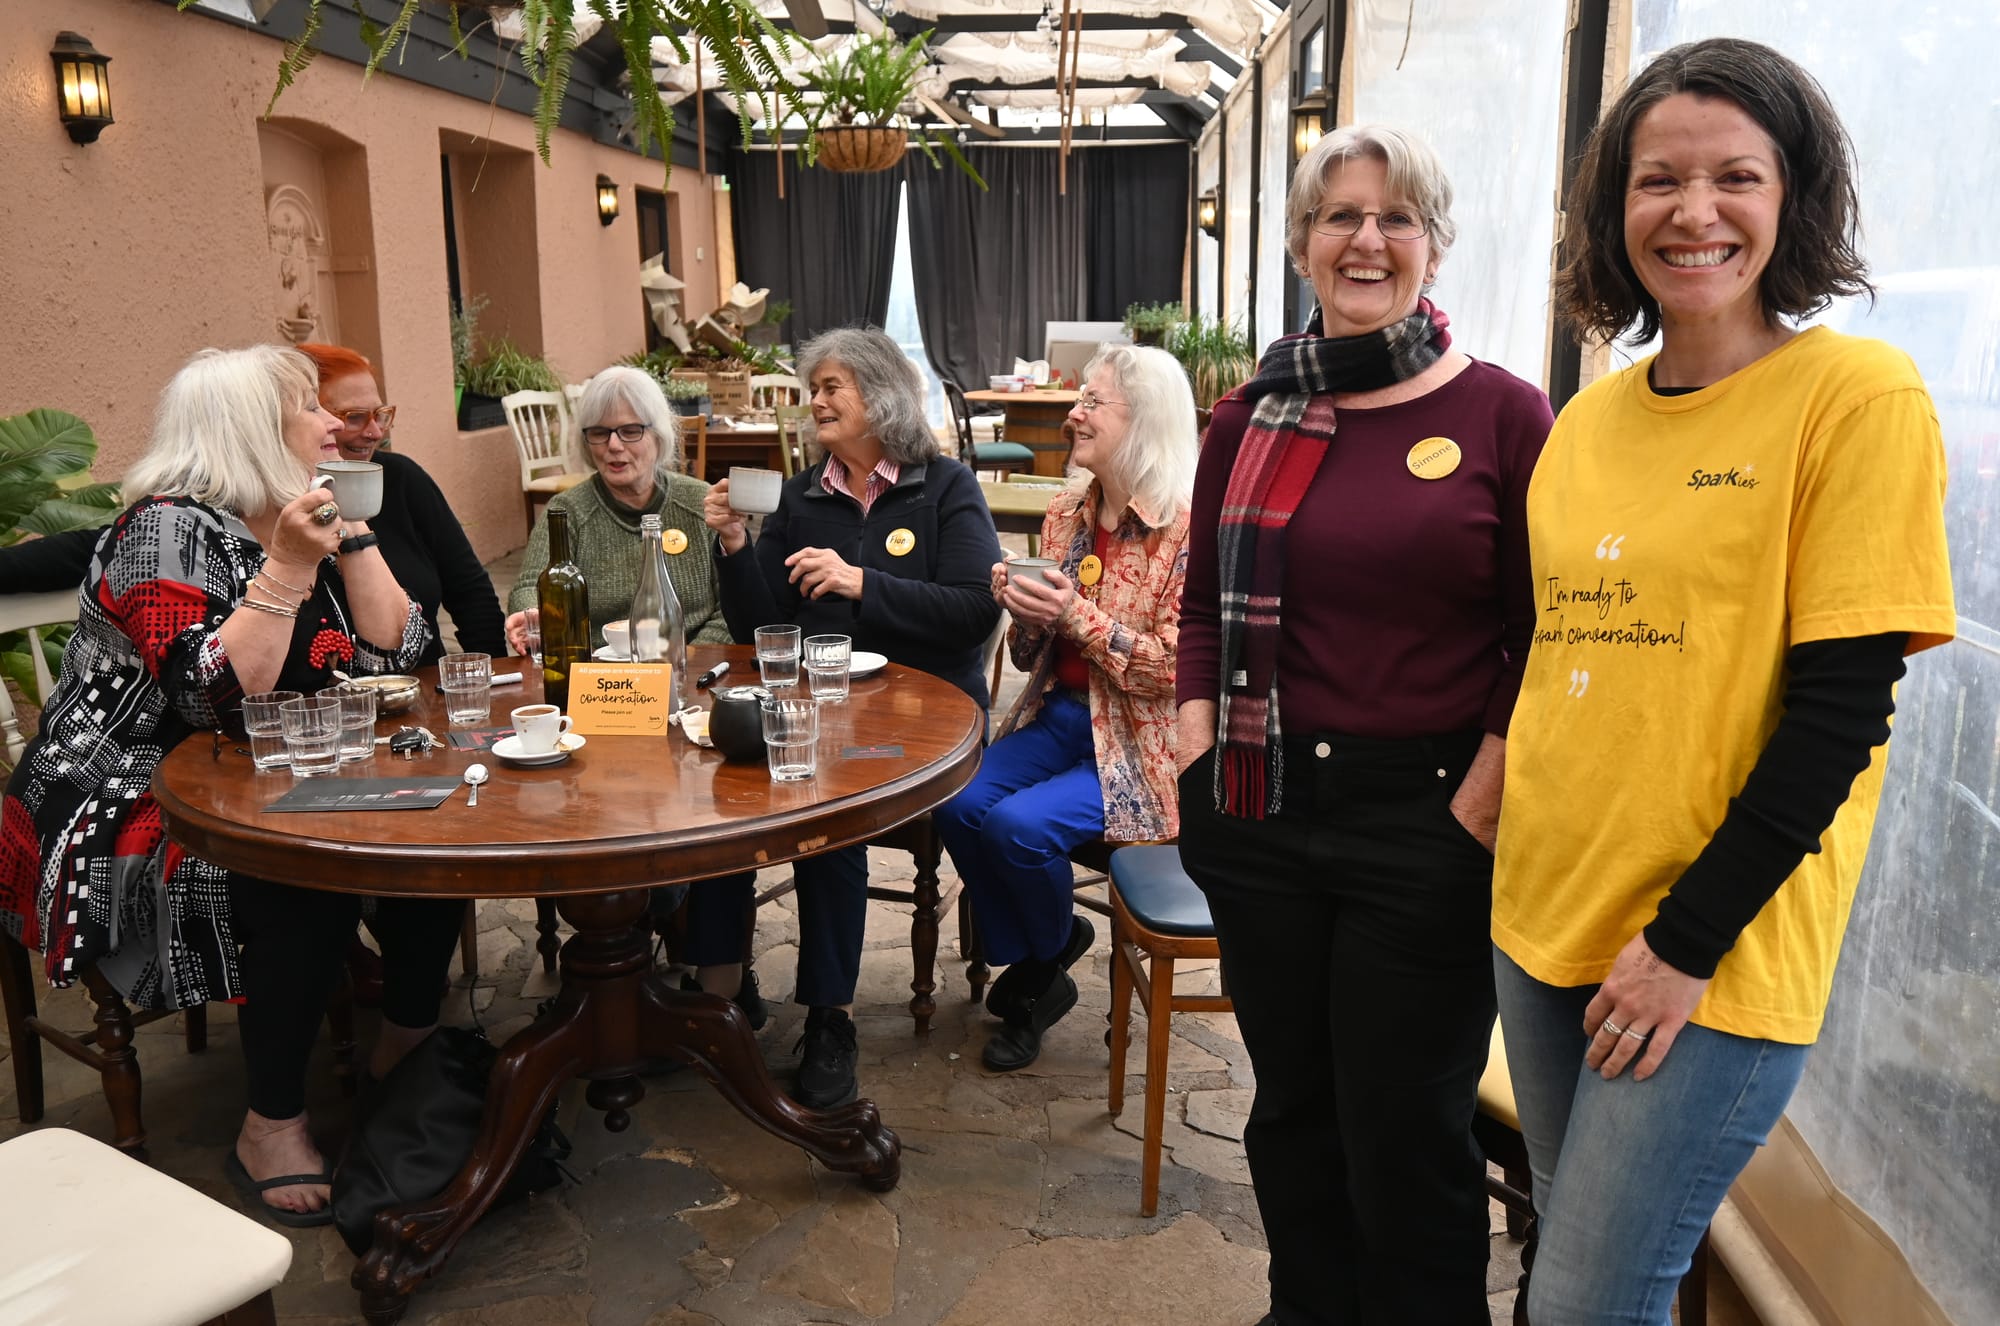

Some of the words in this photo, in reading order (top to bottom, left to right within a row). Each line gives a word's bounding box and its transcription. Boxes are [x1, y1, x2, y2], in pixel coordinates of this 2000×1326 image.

[1412, 444, 1453, 470] Simone
[1687, 467, 1760, 491] Sparkies
[1546, 577, 1569, 612] I'm
[1571, 577, 1616, 620] ready
[1614, 578, 1638, 607] to
[1567, 619, 1686, 652] conversation!
[589, 667, 611, 675] people
[596, 678, 634, 692] Spark
[580, 689, 658, 706] conversation
